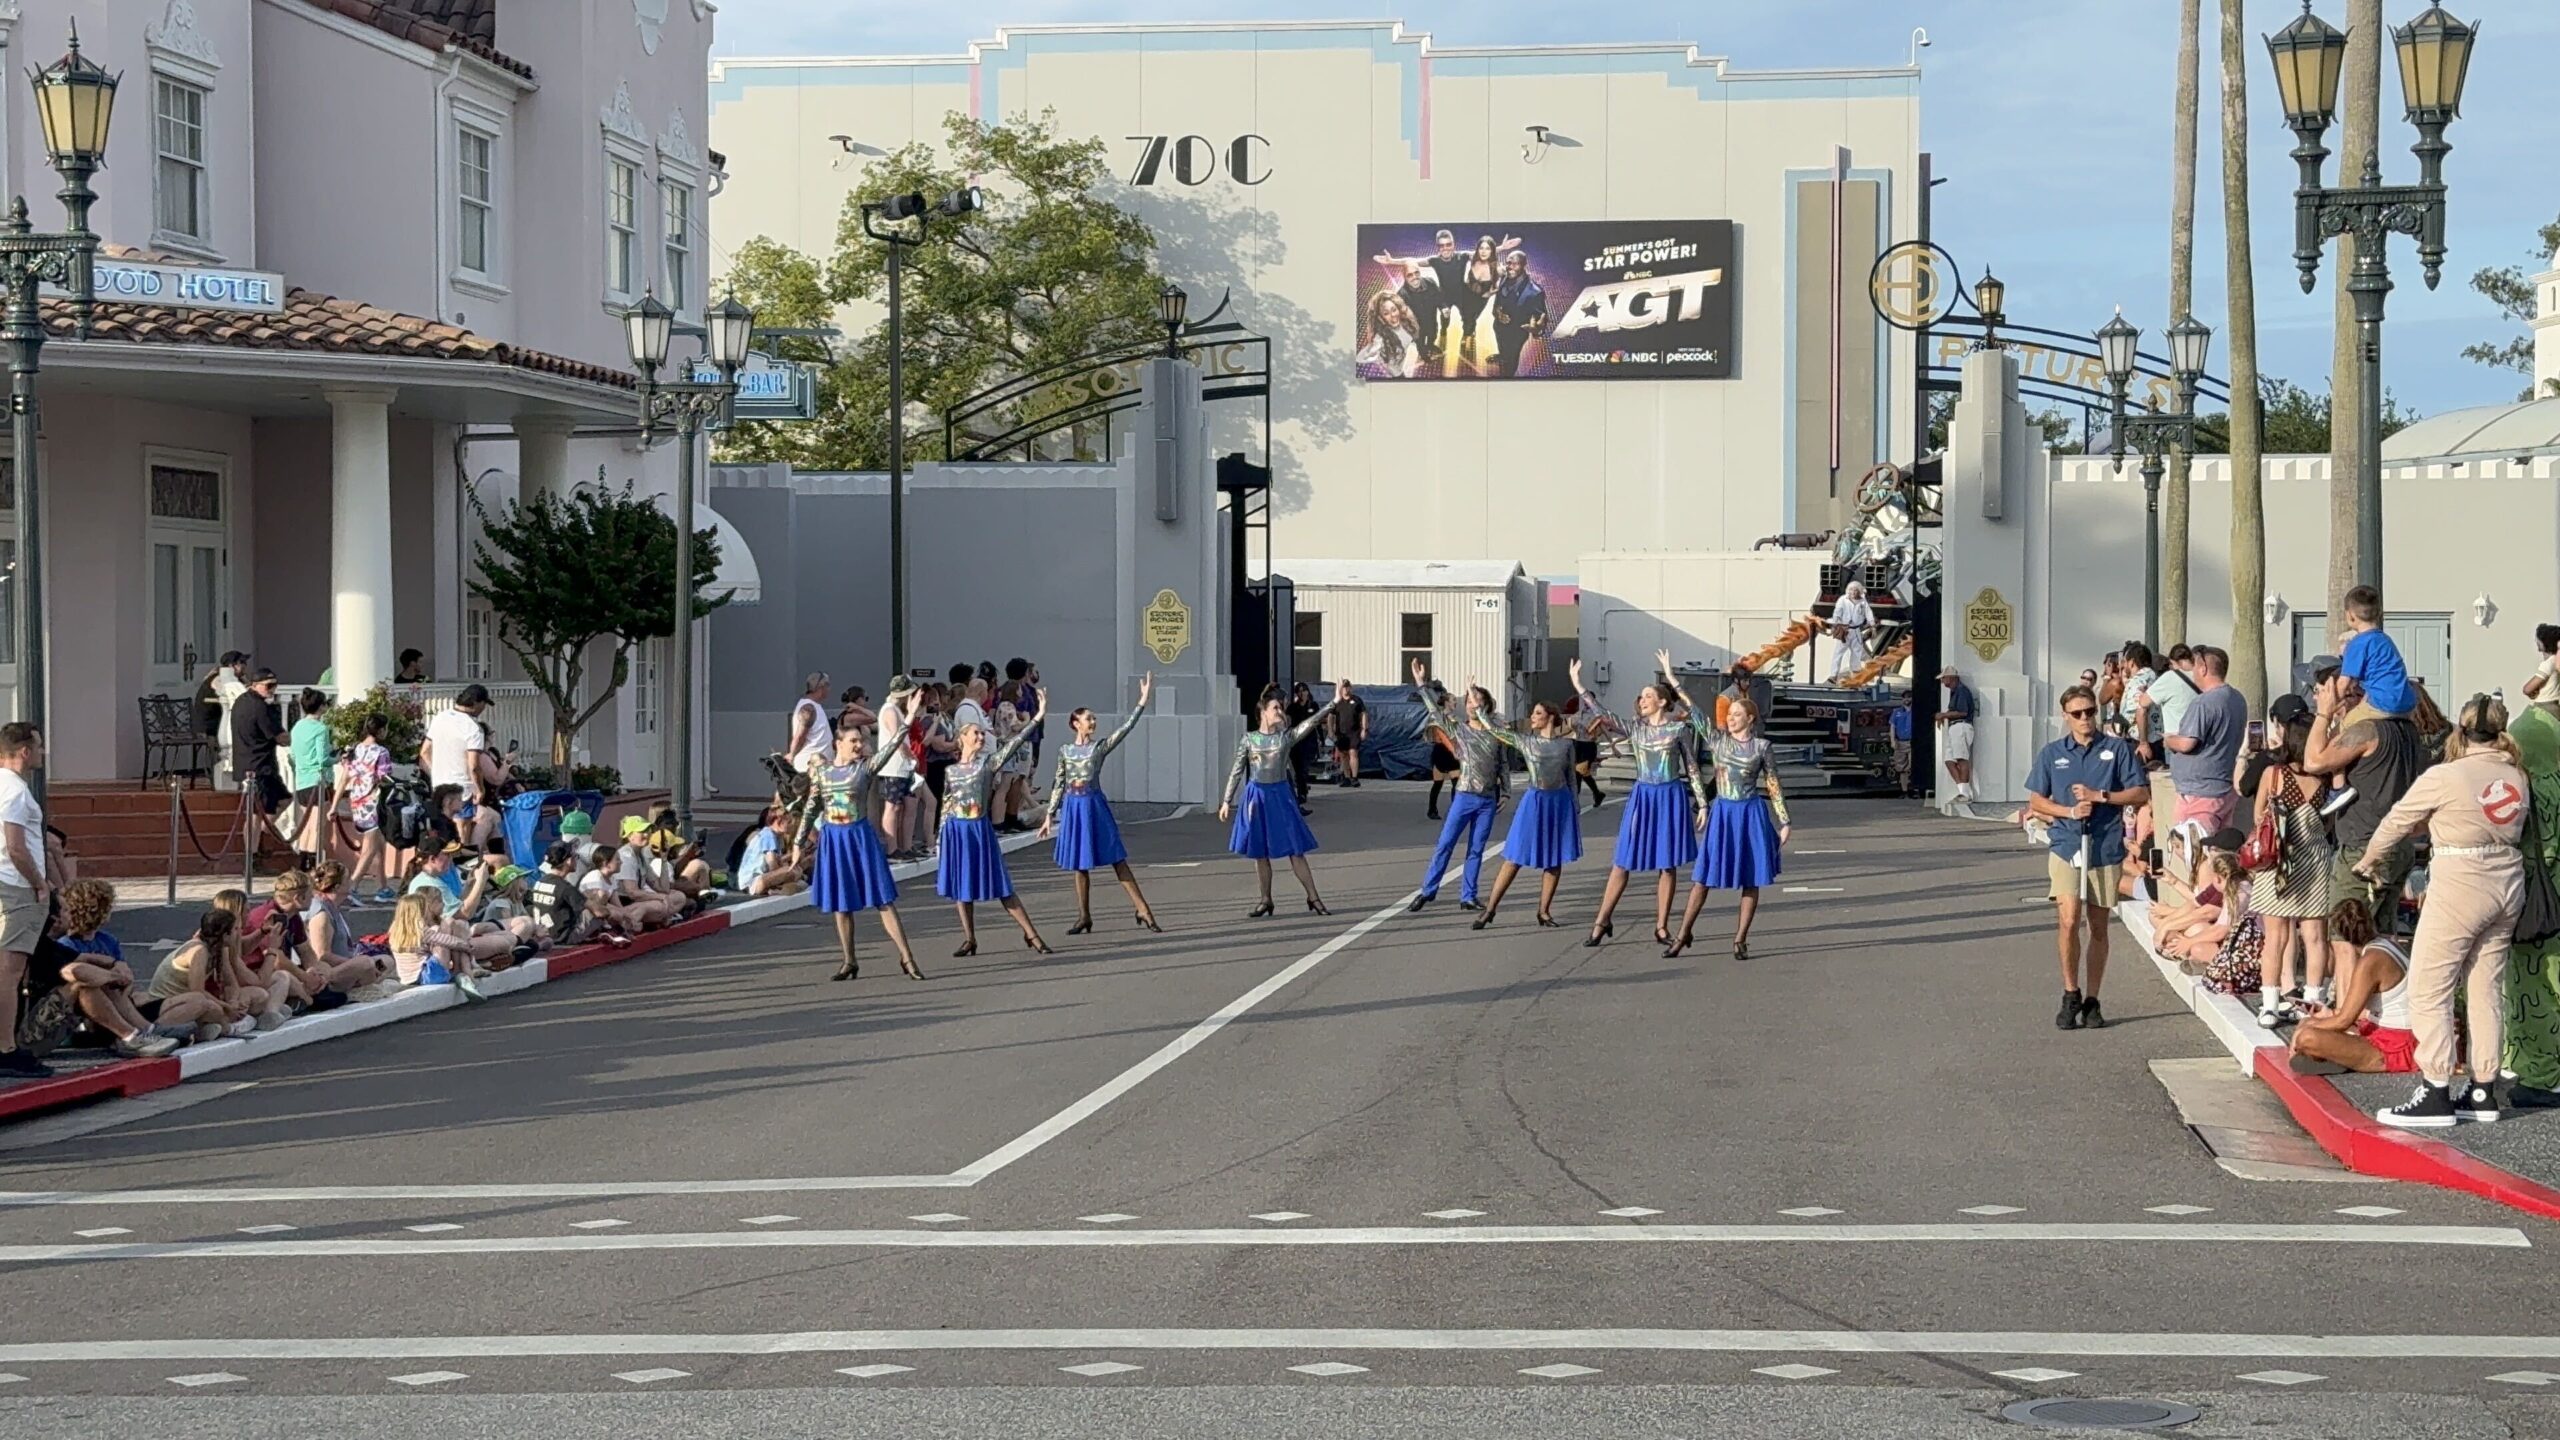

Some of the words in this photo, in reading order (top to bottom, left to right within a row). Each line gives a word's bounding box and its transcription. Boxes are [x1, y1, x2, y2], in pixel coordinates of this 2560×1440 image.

[1655, 238, 1676, 249] GOT
[1584, 254, 1625, 271] STAR
[1630, 244, 1698, 266] POWER!
[177, 273, 275, 305] HOTEL
[1552, 268, 1722, 339] AGT
[1553, 352, 1608, 364] TUESDAY
[1631, 353, 1658, 363] NBC
[1666, 350, 1714, 366] peacock
[751, 372, 786, 395] BAR
[1475, 599, 1499, 608] T-61
[1970, 622, 2008, 638] 6300
